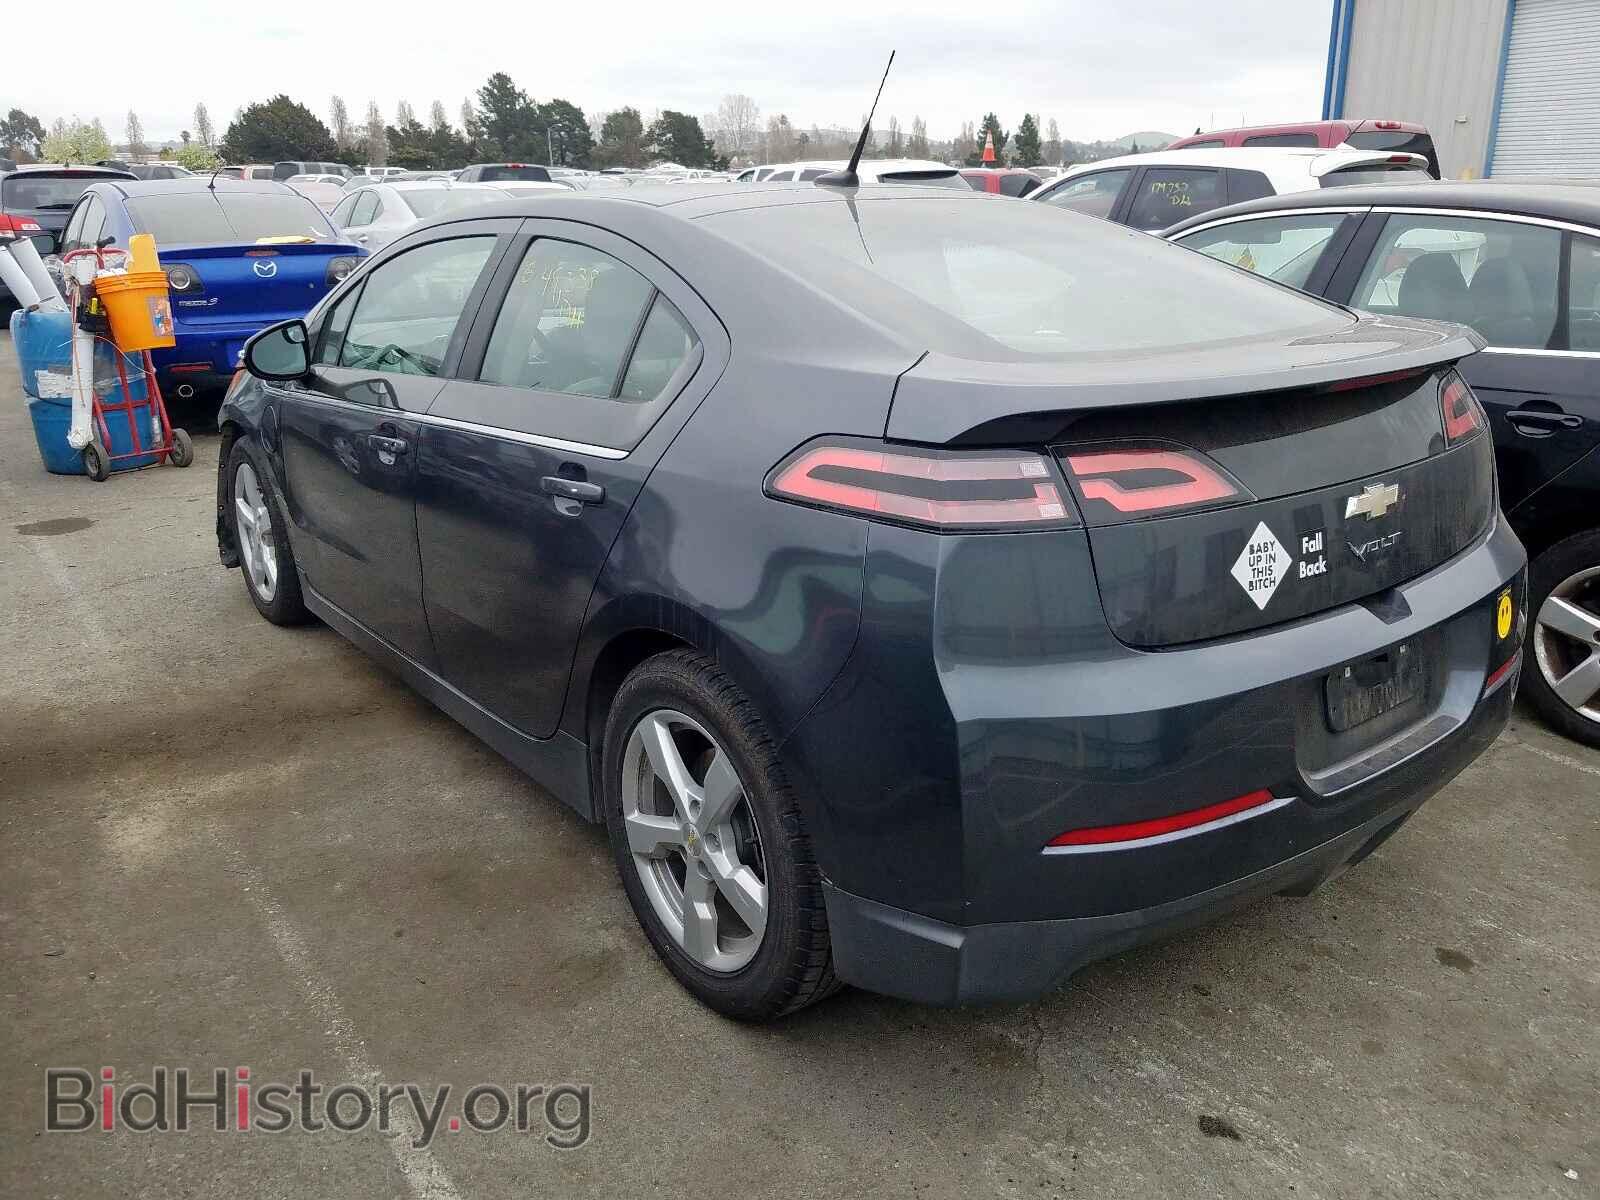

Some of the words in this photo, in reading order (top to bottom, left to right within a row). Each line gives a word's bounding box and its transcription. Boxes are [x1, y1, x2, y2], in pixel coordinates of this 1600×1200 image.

[1249, 541, 1276, 555] BABY
[1302, 532, 1323, 554] Fall
[1346, 532, 1402, 561] VOLT
[1249, 555, 1262, 567] UP
[1265, 553, 1276, 564] IN
[1299, 555, 1327, 579] Back
[1251, 565, 1273, 578] THIS
[1248, 577, 1276, 591] BITCH
